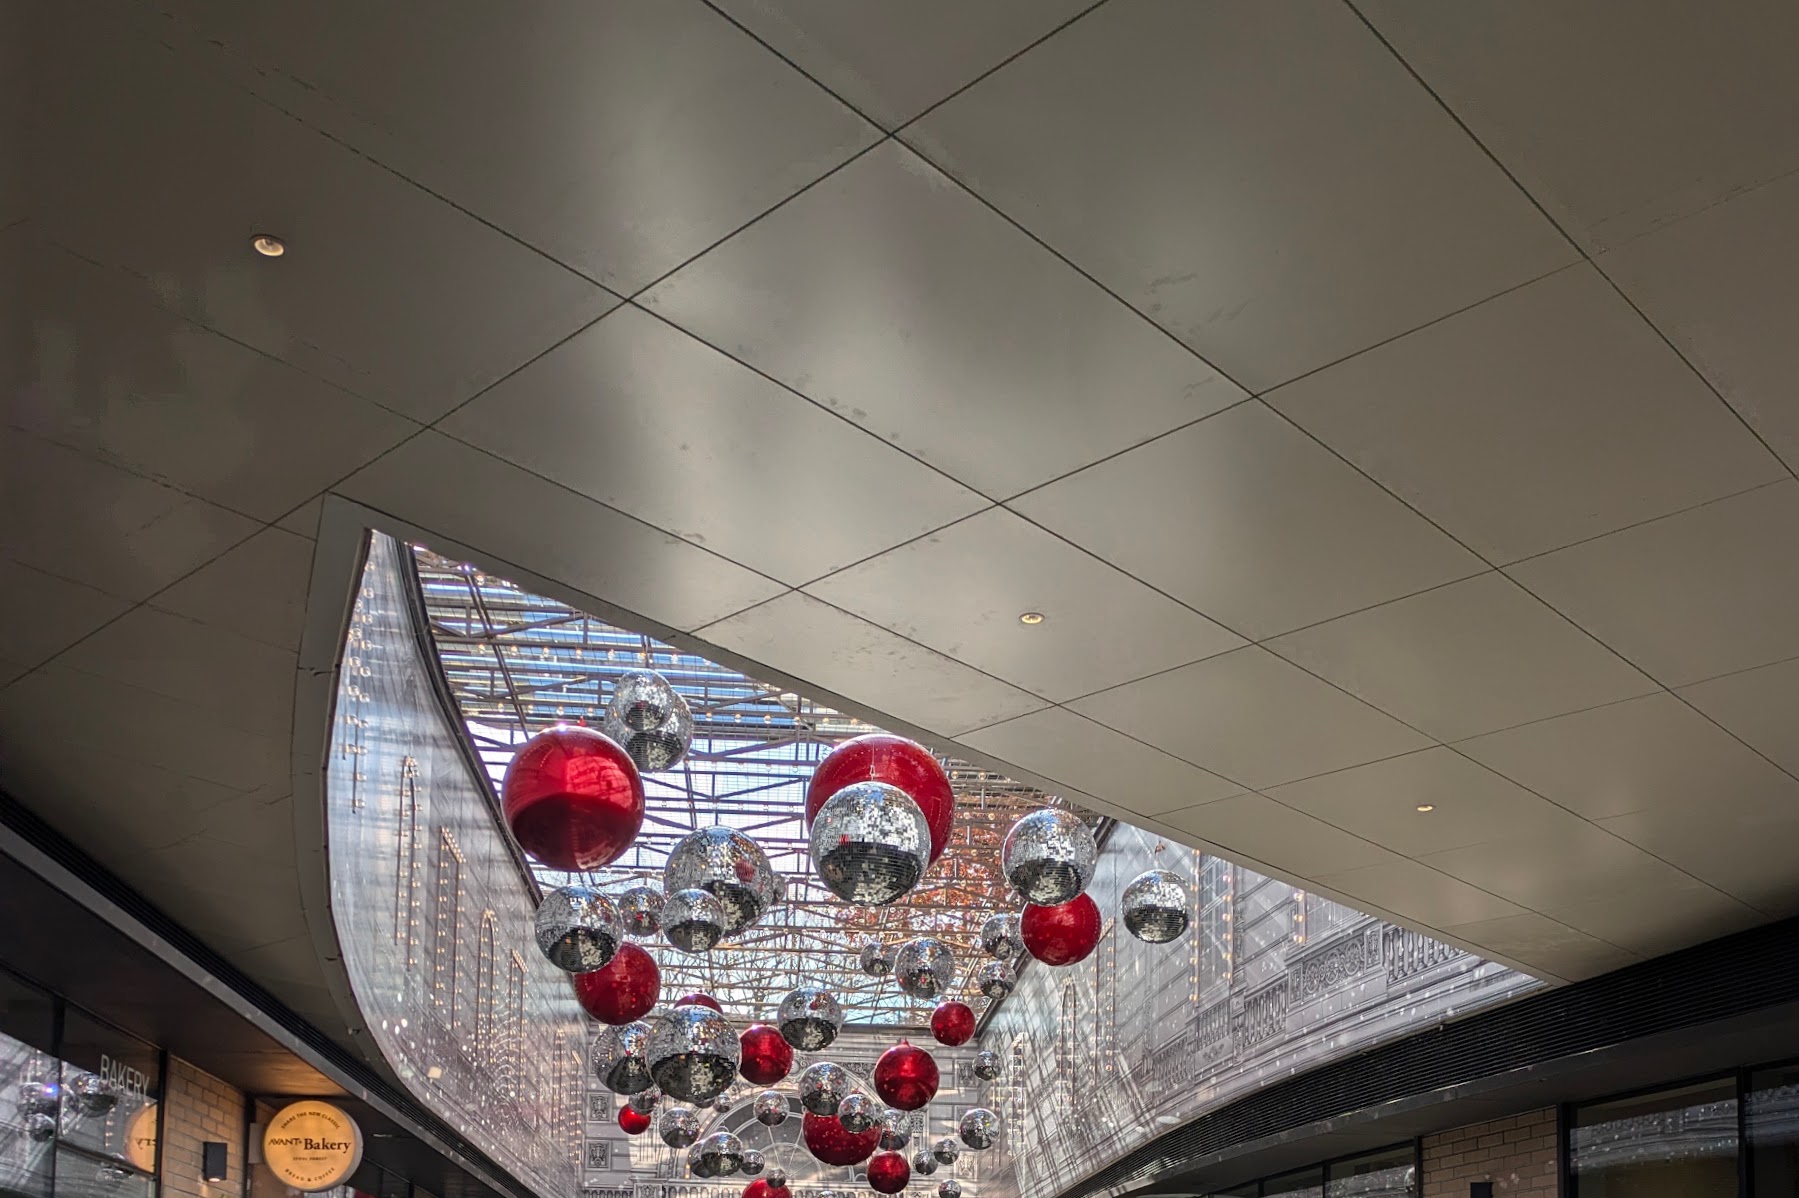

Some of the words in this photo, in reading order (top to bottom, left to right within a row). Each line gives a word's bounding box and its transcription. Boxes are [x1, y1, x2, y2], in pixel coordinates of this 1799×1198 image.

[100, 1053, 150, 1100] BAKERY
[296, 1111, 307, 1119] THE
[321, 1113, 340, 1130] CLASSIC
[303, 1137, 352, 1154] Bakery
[284, 1168, 305, 1182] BREAD
[314, 1167, 335, 1181] COFFEE
